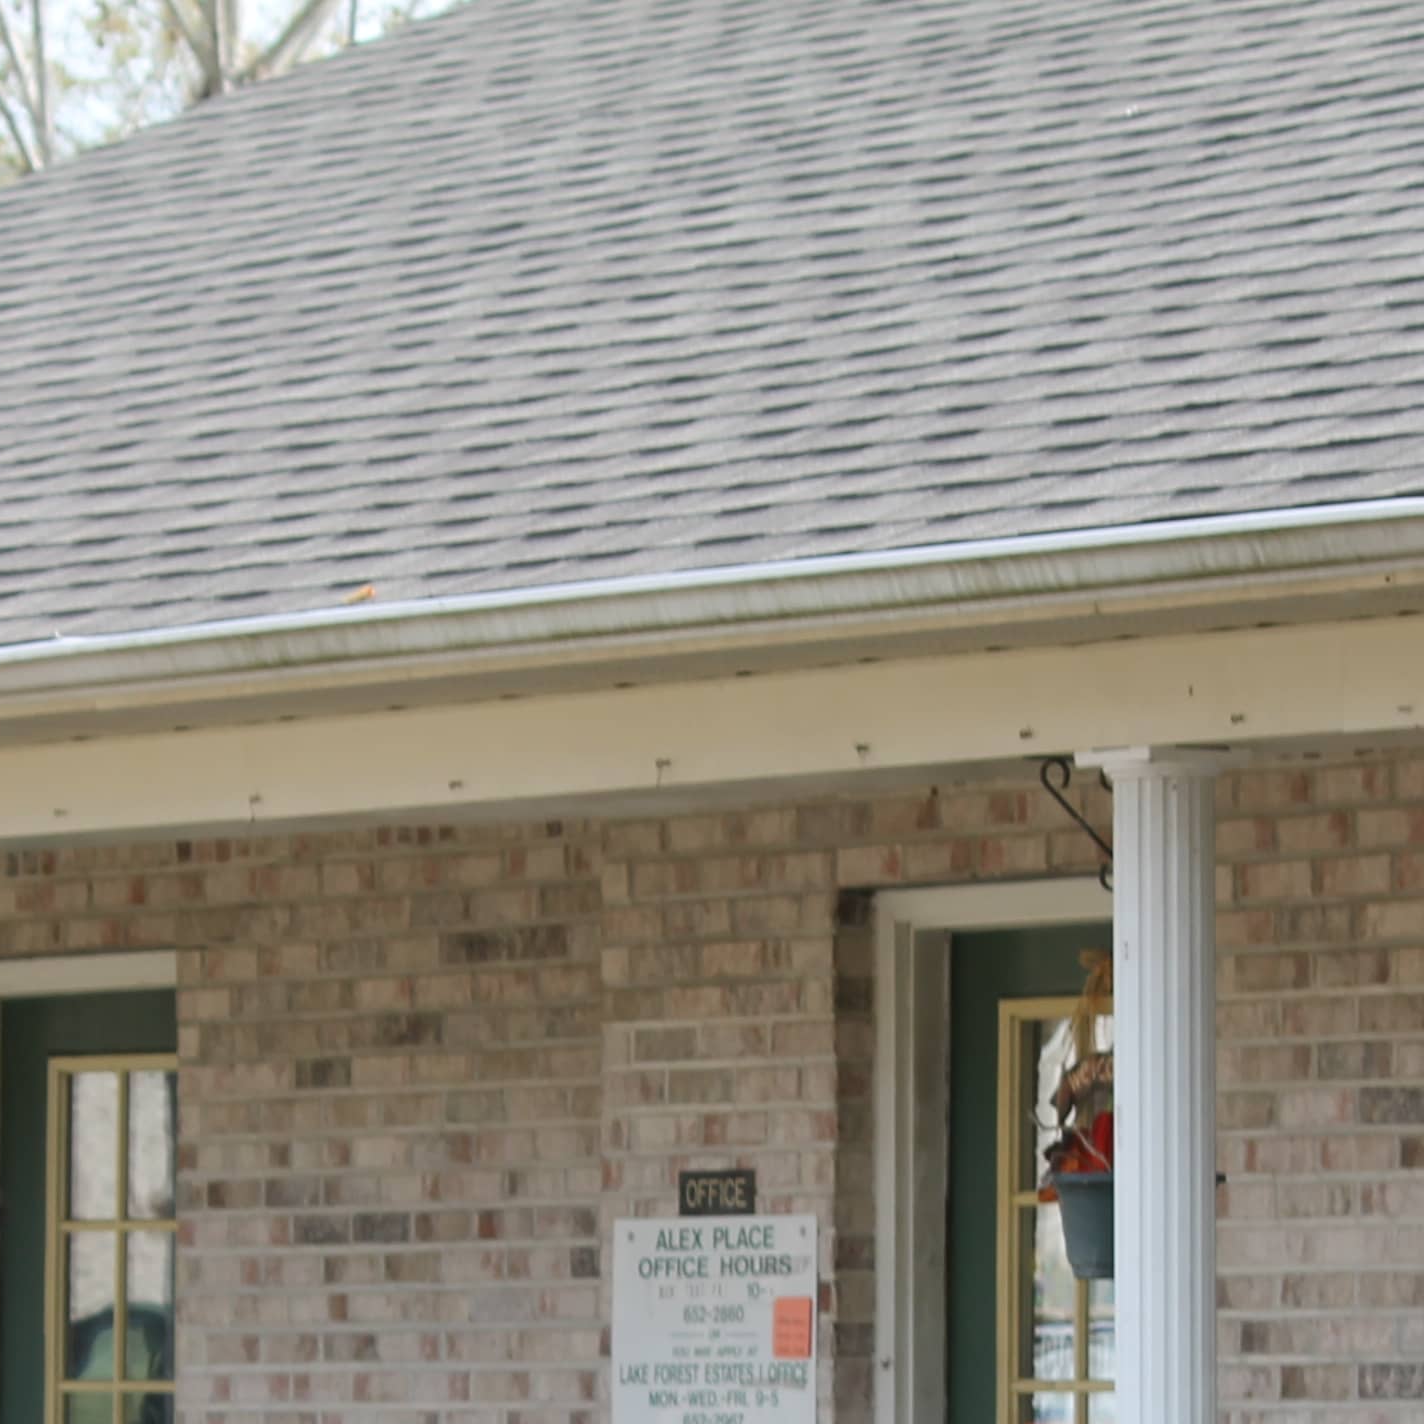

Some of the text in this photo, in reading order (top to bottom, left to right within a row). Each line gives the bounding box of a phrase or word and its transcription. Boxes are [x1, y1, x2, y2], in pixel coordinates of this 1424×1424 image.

[686, 1178, 746, 1207] OFFICE
[656, 1225, 774, 1251] ALEX PLACE
[639, 1256, 708, 1279] OFFICE
[720, 1254, 792, 1277] HOURS
[619, 1363, 648, 1385] LAKE
[654, 1363, 698, 1385] FOREST
[704, 1362, 753, 1385] ESTATES
[767, 1362, 808, 1386] OFFICE
[755, 1390, 779, 1407] 9-5
